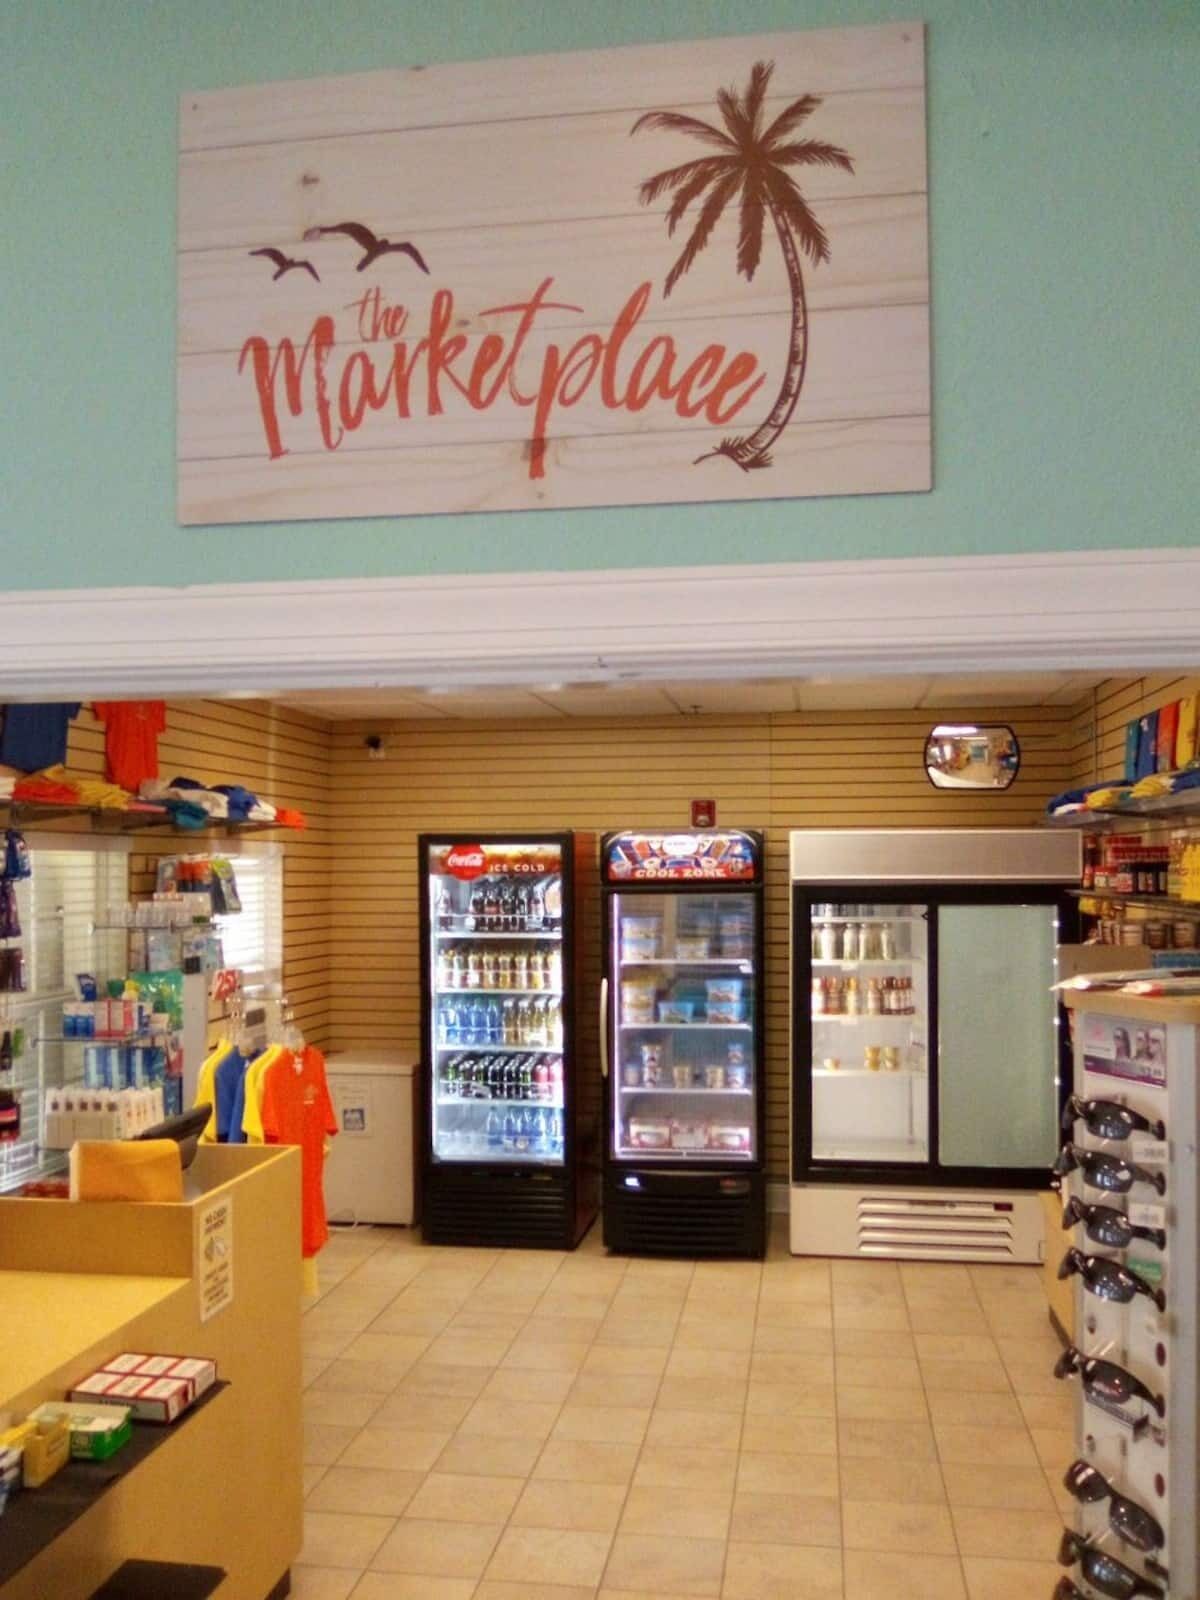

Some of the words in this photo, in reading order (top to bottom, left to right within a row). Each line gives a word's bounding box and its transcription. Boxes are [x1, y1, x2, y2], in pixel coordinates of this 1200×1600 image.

[343, 286, 409, 343] the
[238, 277, 767, 479] Marketplace
[489, 863, 508, 873] ICE
[513, 863, 545, 873] COLD
[633, 868, 679, 879] COOL
[682, 868, 727, 878] ZONE
